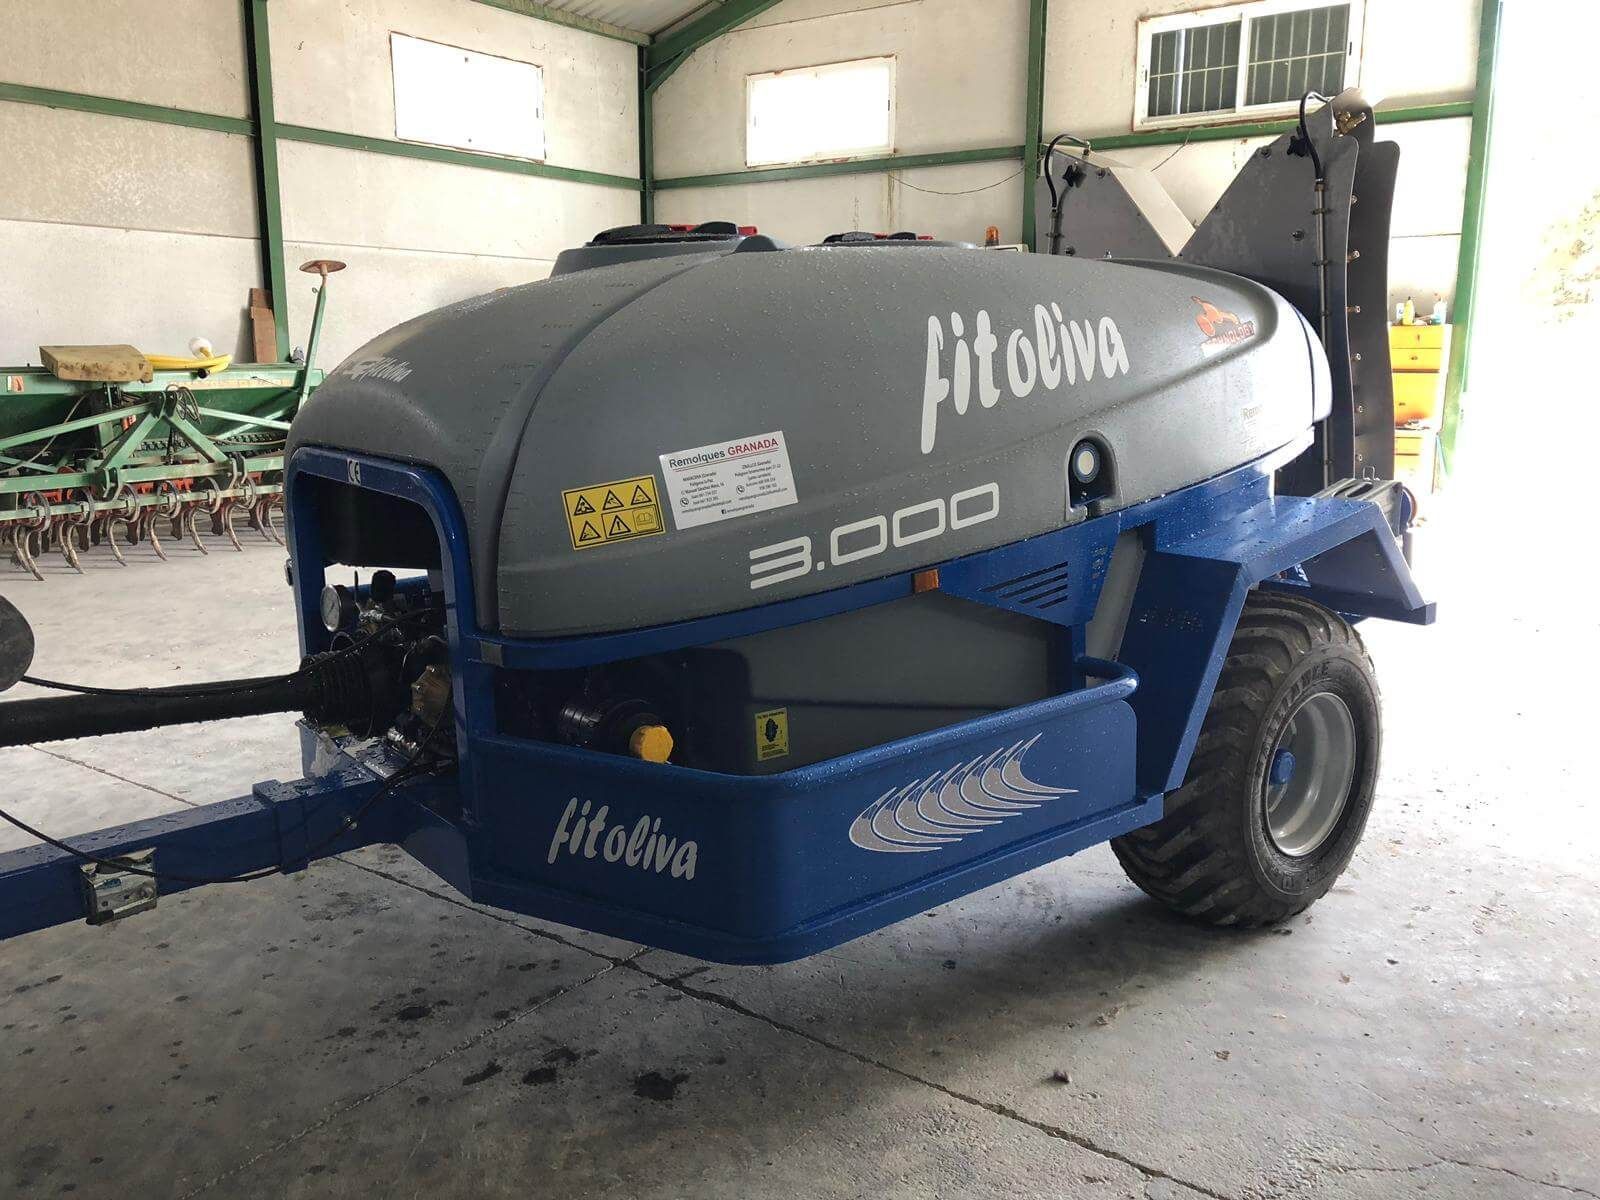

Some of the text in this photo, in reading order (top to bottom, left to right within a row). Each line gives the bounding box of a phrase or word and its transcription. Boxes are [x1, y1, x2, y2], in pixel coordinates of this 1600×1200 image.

[921, 302, 1130, 454] fitoliva
[669, 450, 726, 469] Remolques
[727, 438, 779, 456] GRANADA
[749, 482, 1000, 590] 3.000
[547, 797, 698, 881] fitoliva
